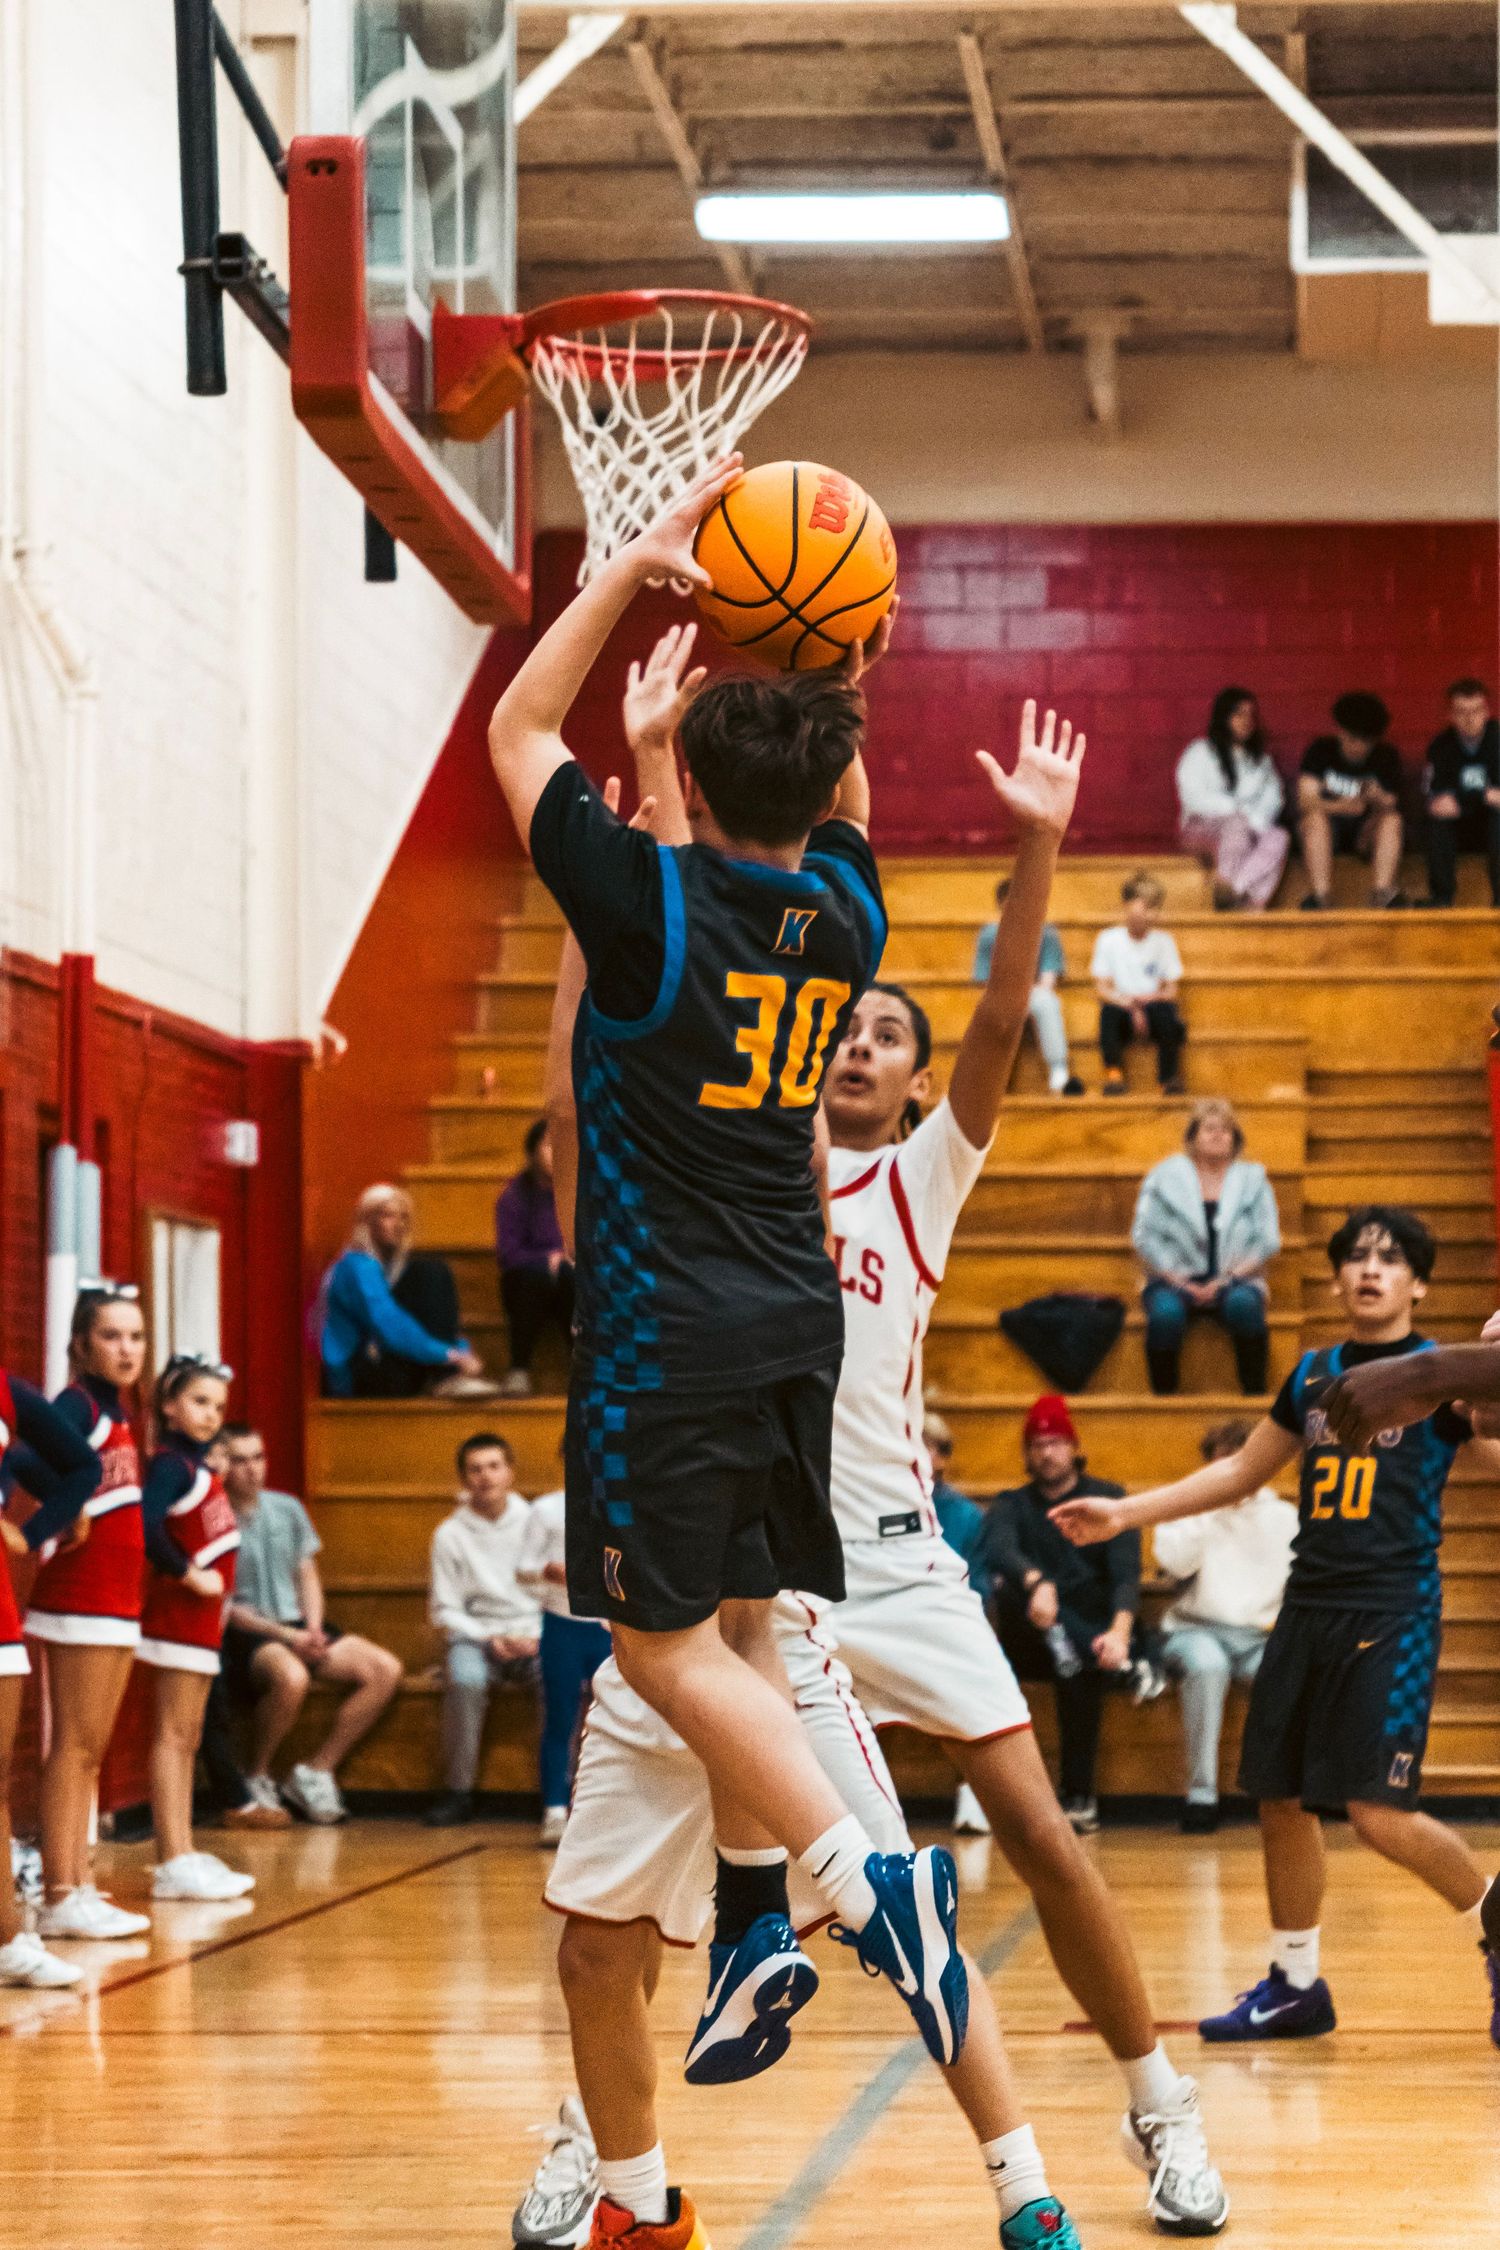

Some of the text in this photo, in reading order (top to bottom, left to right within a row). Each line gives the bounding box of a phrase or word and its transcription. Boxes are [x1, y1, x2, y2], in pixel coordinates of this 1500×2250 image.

[770, 907, 819, 956] K
[697, 970, 852, 1110] 30
[1310, 1455, 1378, 1520] 20
